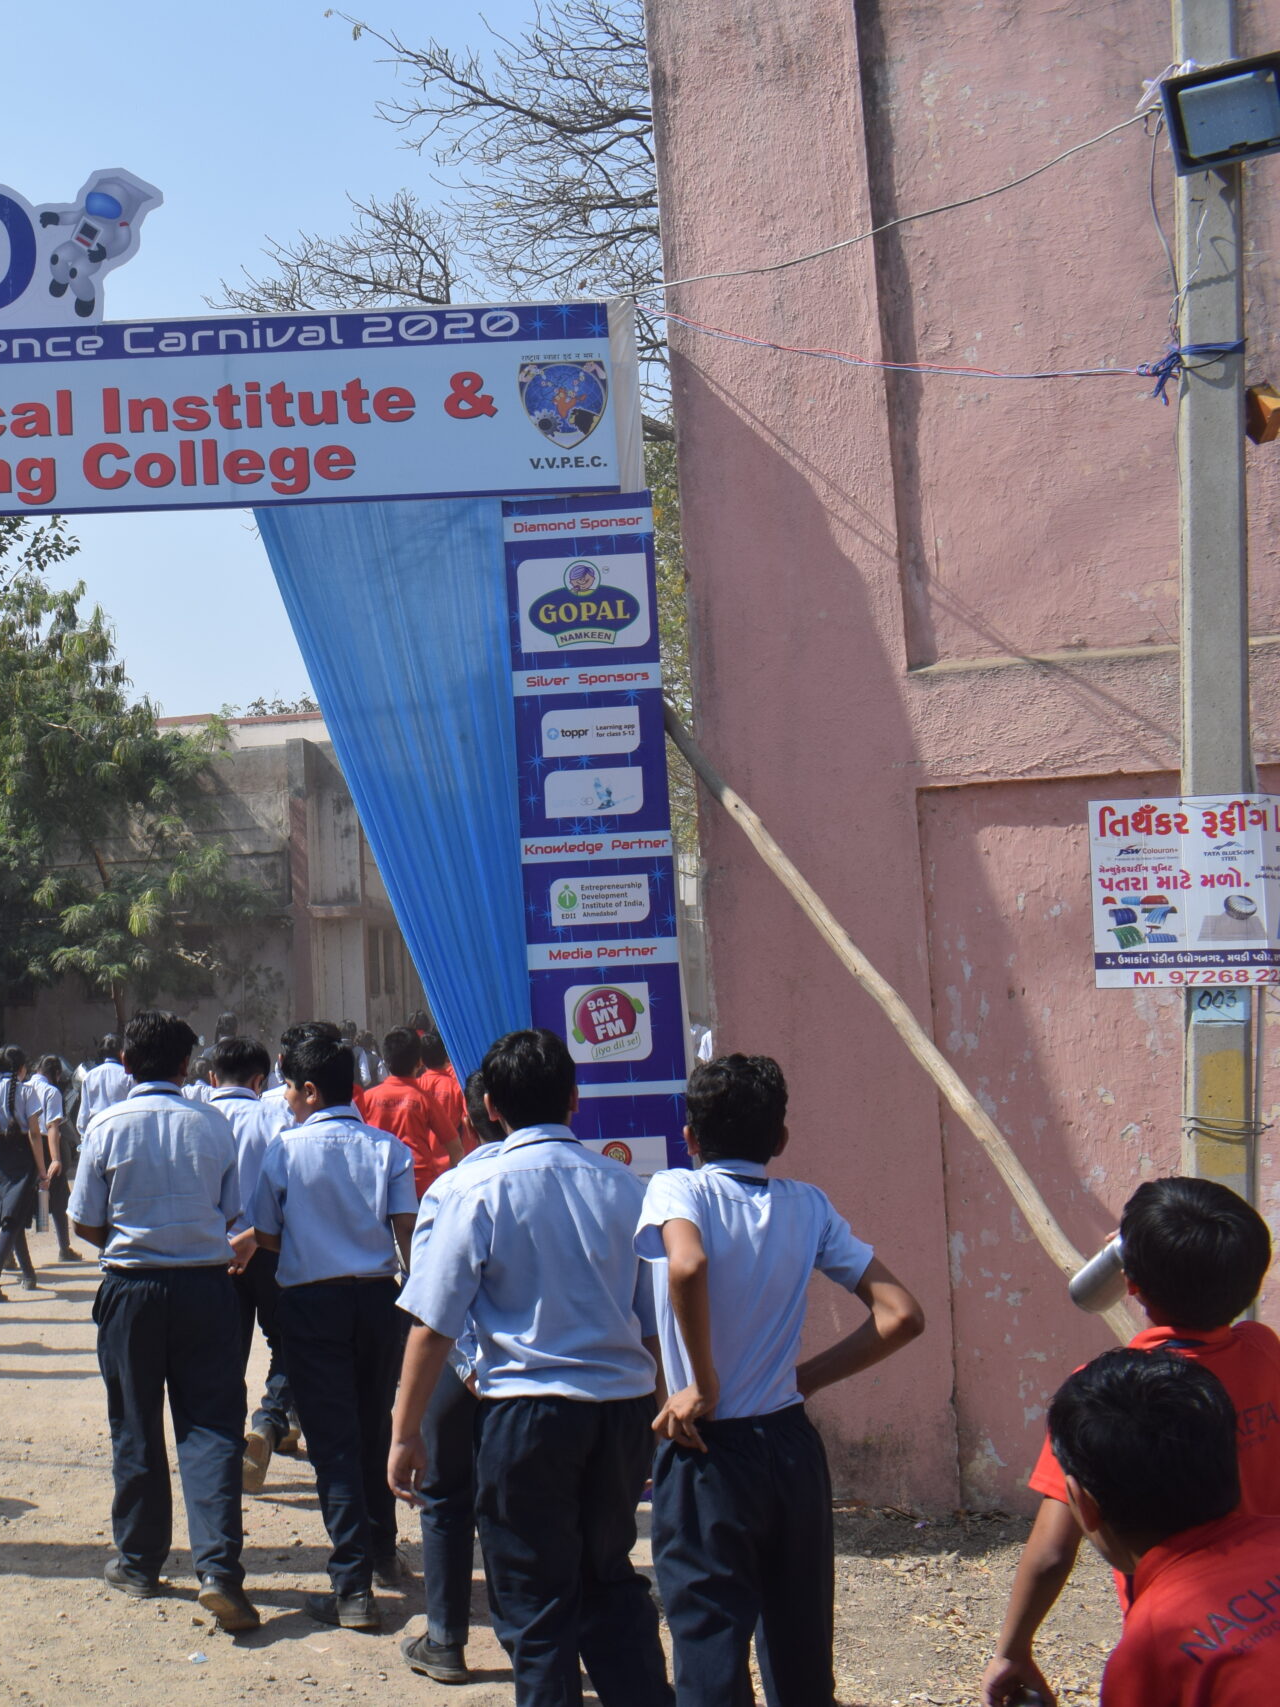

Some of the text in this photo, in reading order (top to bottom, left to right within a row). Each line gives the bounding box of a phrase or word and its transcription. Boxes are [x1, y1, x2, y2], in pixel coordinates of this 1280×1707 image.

[124, 319, 345, 355] Carnival
[361, 310, 521, 345] 2020
[101, 377, 417, 434] Institute
[442, 371, 498, 419] &
[82, 438, 356, 495] College
[529, 456, 609, 470] V.V.P.E.C.
[513, 515, 643, 533] Diamond Sponsor
[538, 600, 630, 624] GOPAL
[560, 631, 612, 643] NAMKEEN
[526, 672, 650, 688] Silver Sponsors
[560, 728, 589, 738] toppr
[524, 838, 668, 856] Knowledge Partner
[580, 882, 642, 891] Entrepreneurship
[1098, 877, 1148, 892] પતરા
[1156, 869, 1192, 890] માટે
[581, 892, 628, 900] Development
[624, 900, 645, 908] India,
[549, 946, 657, 961] Media Partner
[1133, 968, 1280, 985] M. 97268 22
[586, 993, 618, 1010] 94.3
[1197, 990, 1238, 1010] 003
[591, 1005, 619, 1025] MY
[595, 1019, 627, 1040] FM
